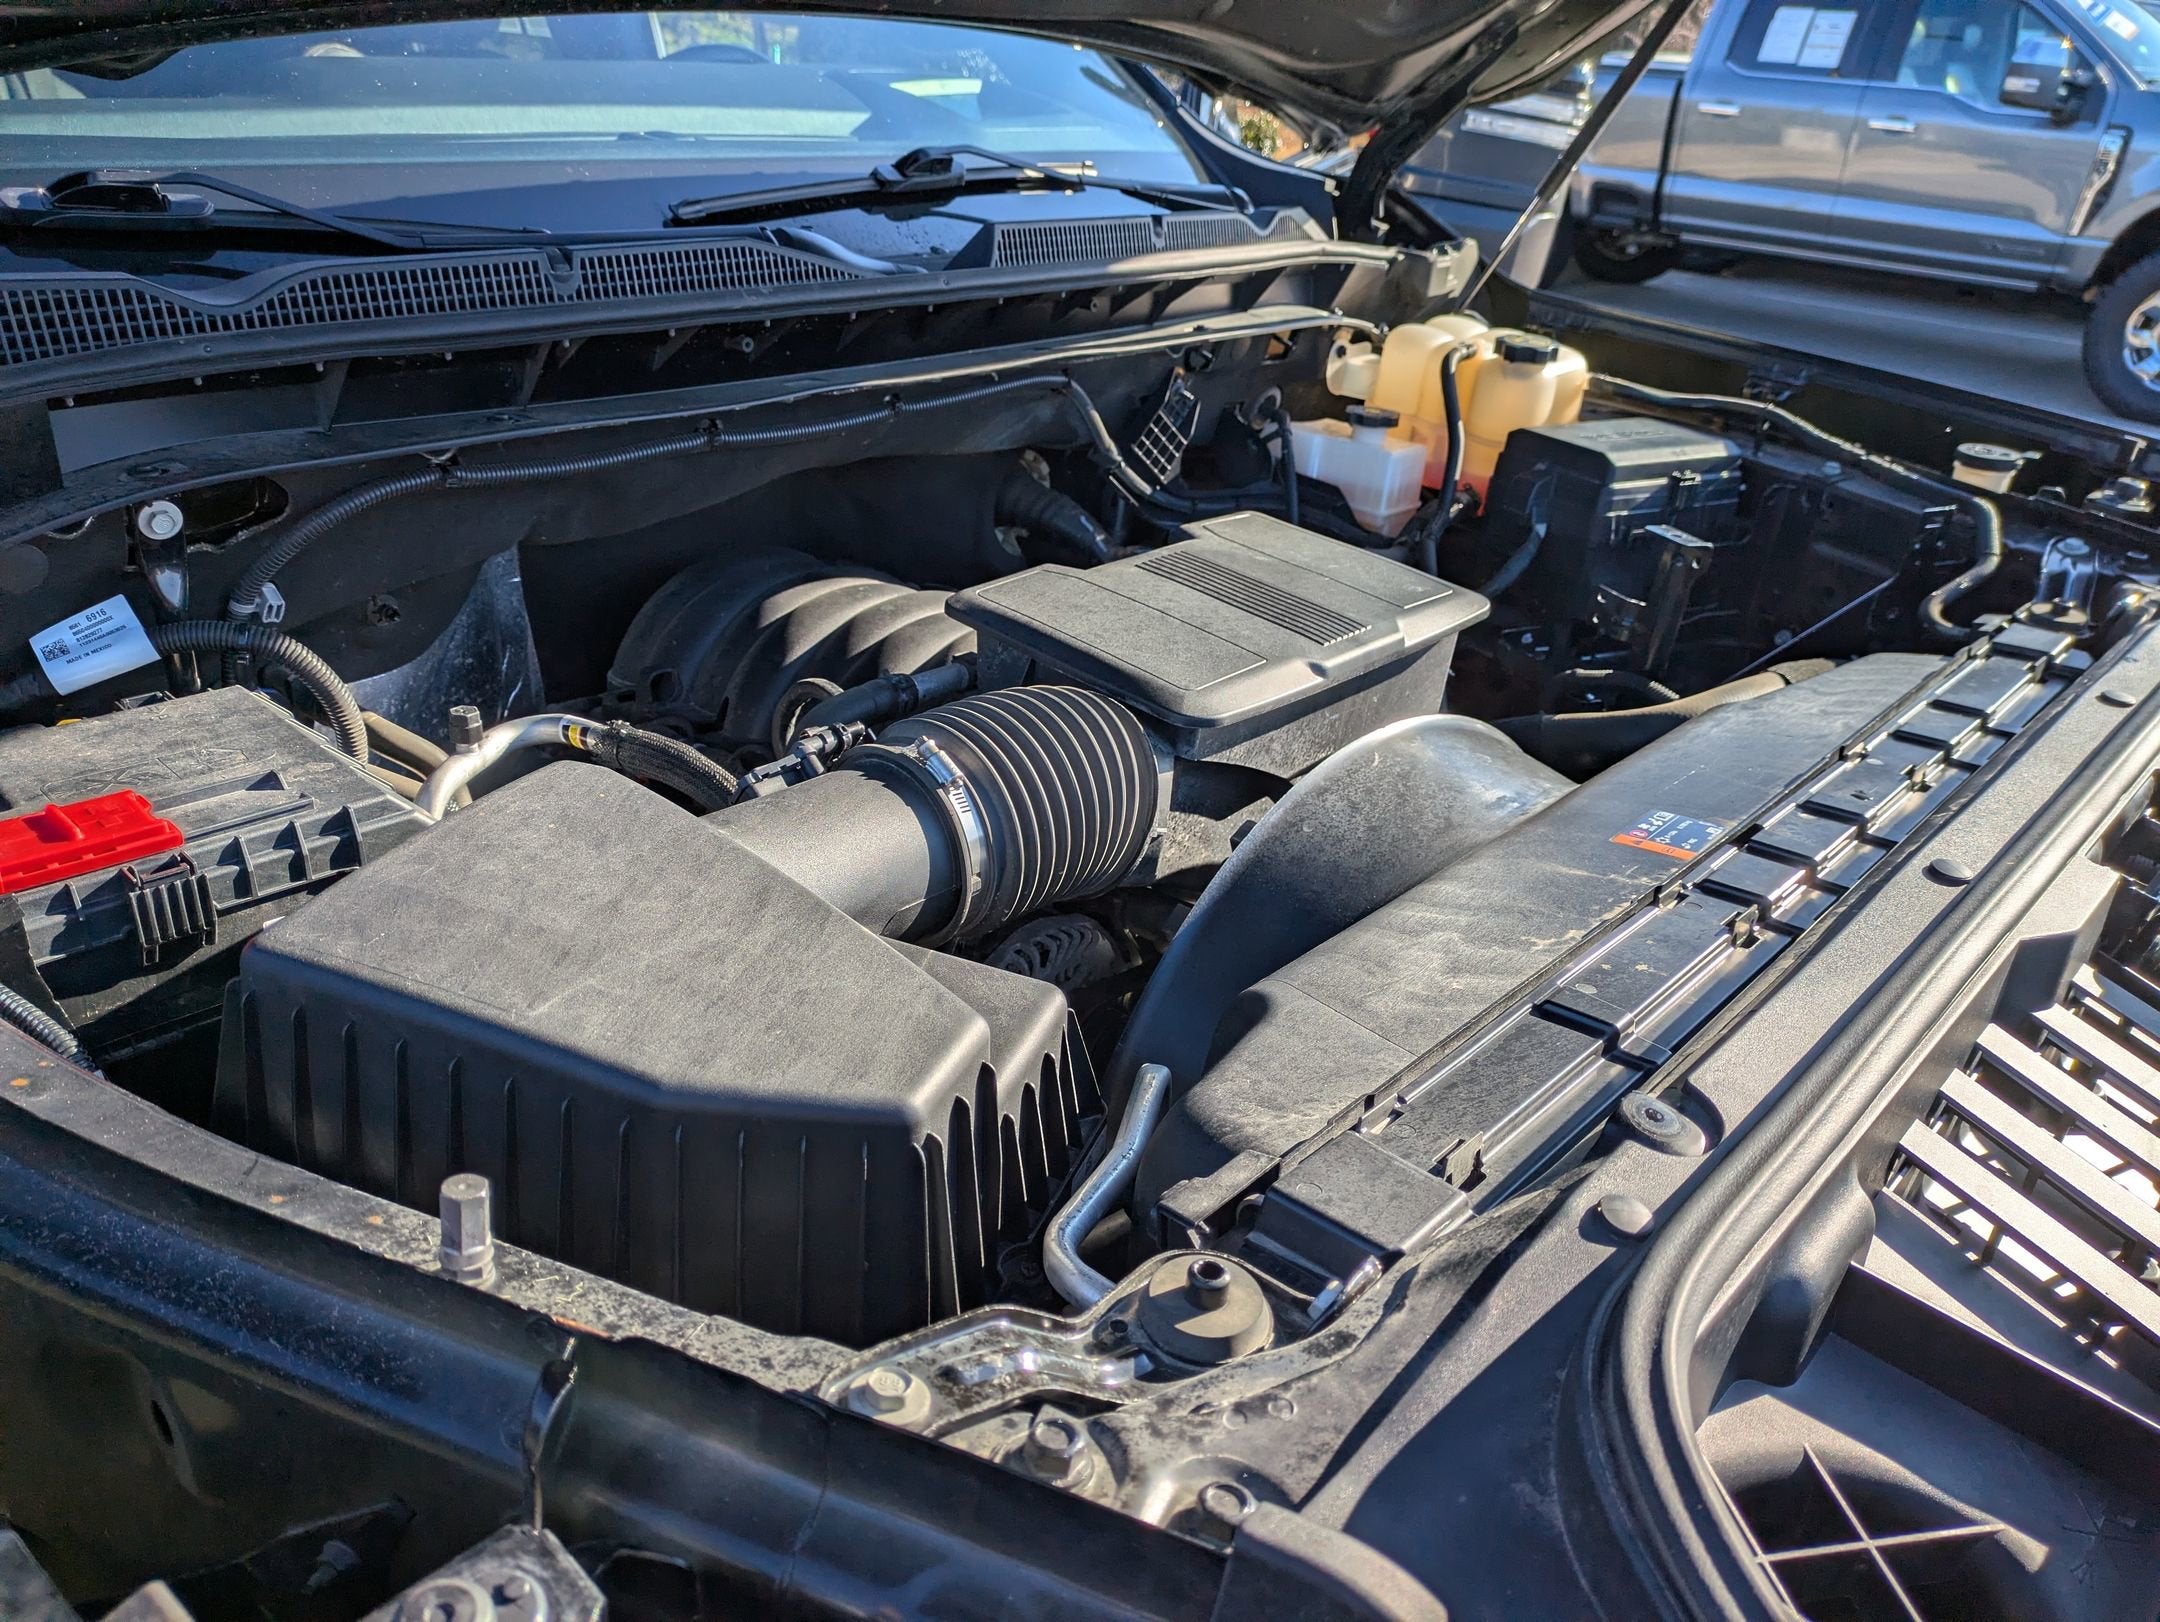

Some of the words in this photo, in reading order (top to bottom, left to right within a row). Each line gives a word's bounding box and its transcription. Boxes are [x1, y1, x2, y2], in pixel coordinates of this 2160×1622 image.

[86, 608, 107, 622] 6916
[66, 655, 82, 664] MADE
[91, 643, 112, 654] MEXICO
